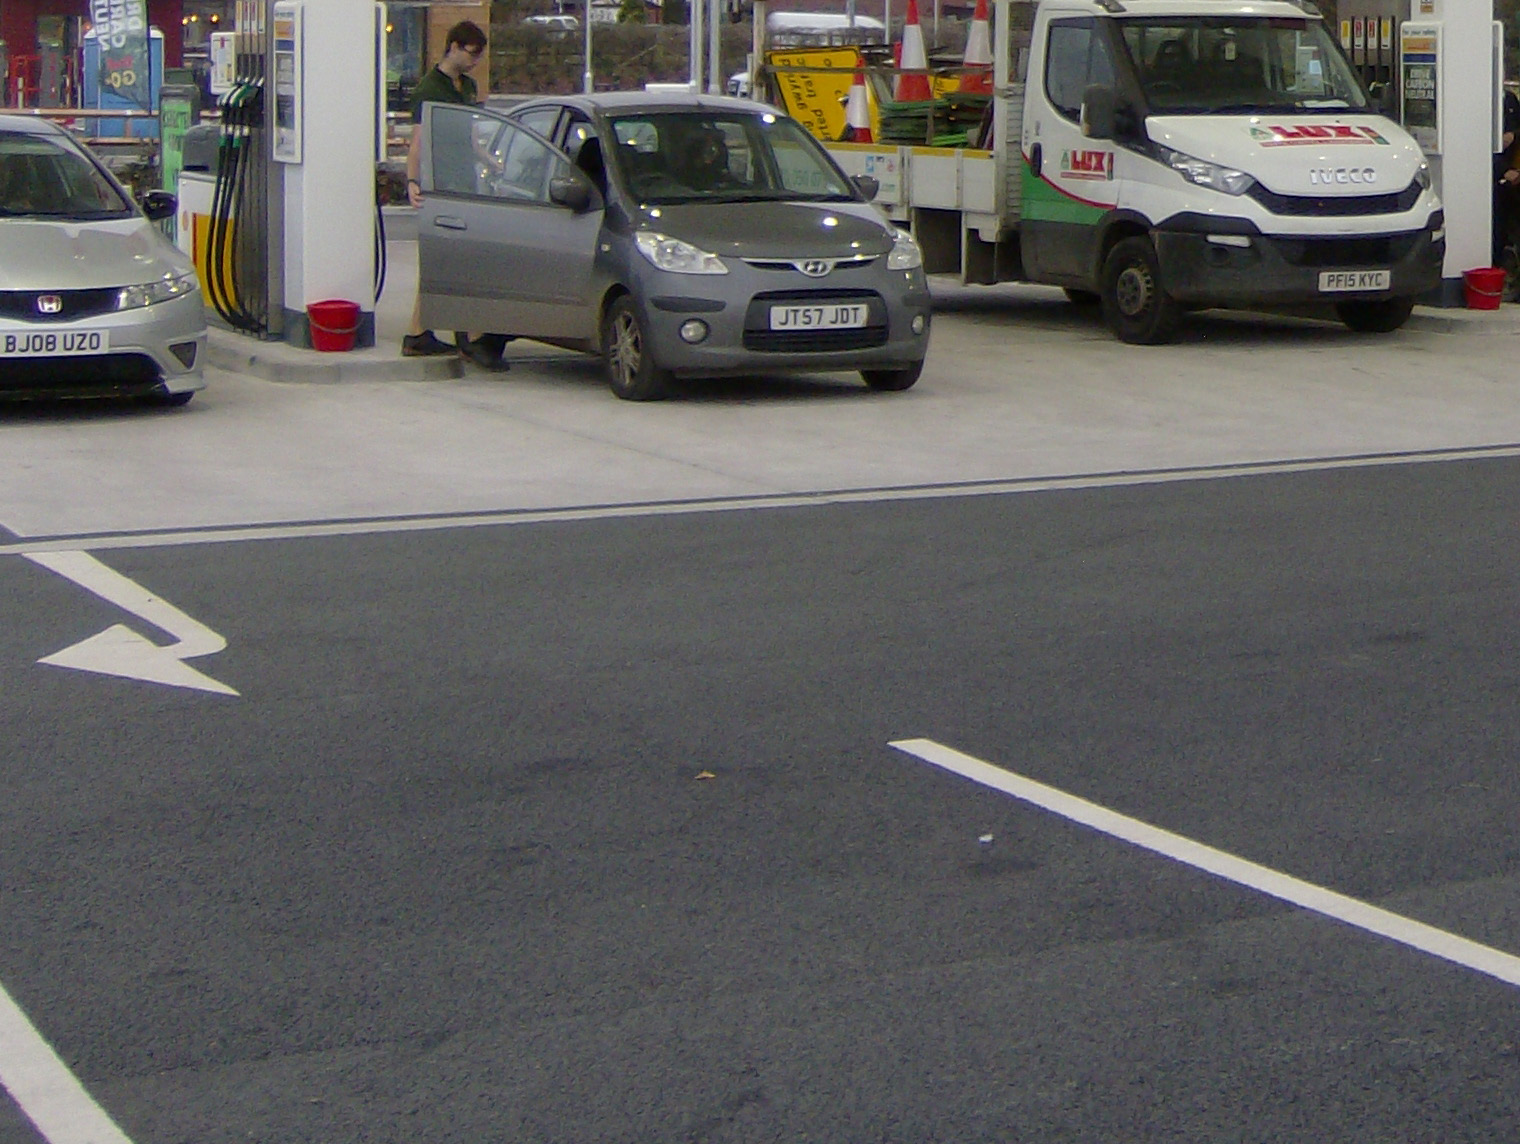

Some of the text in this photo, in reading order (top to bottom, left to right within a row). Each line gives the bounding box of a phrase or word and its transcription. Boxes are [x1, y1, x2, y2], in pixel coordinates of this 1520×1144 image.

[1309, 167, 1377, 185] IVECO
[1327, 272, 1383, 288] PF15 KYC
[779, 307, 860, 326] JT57 JDT
[5, 332, 100, 353] BJ08 UZO
